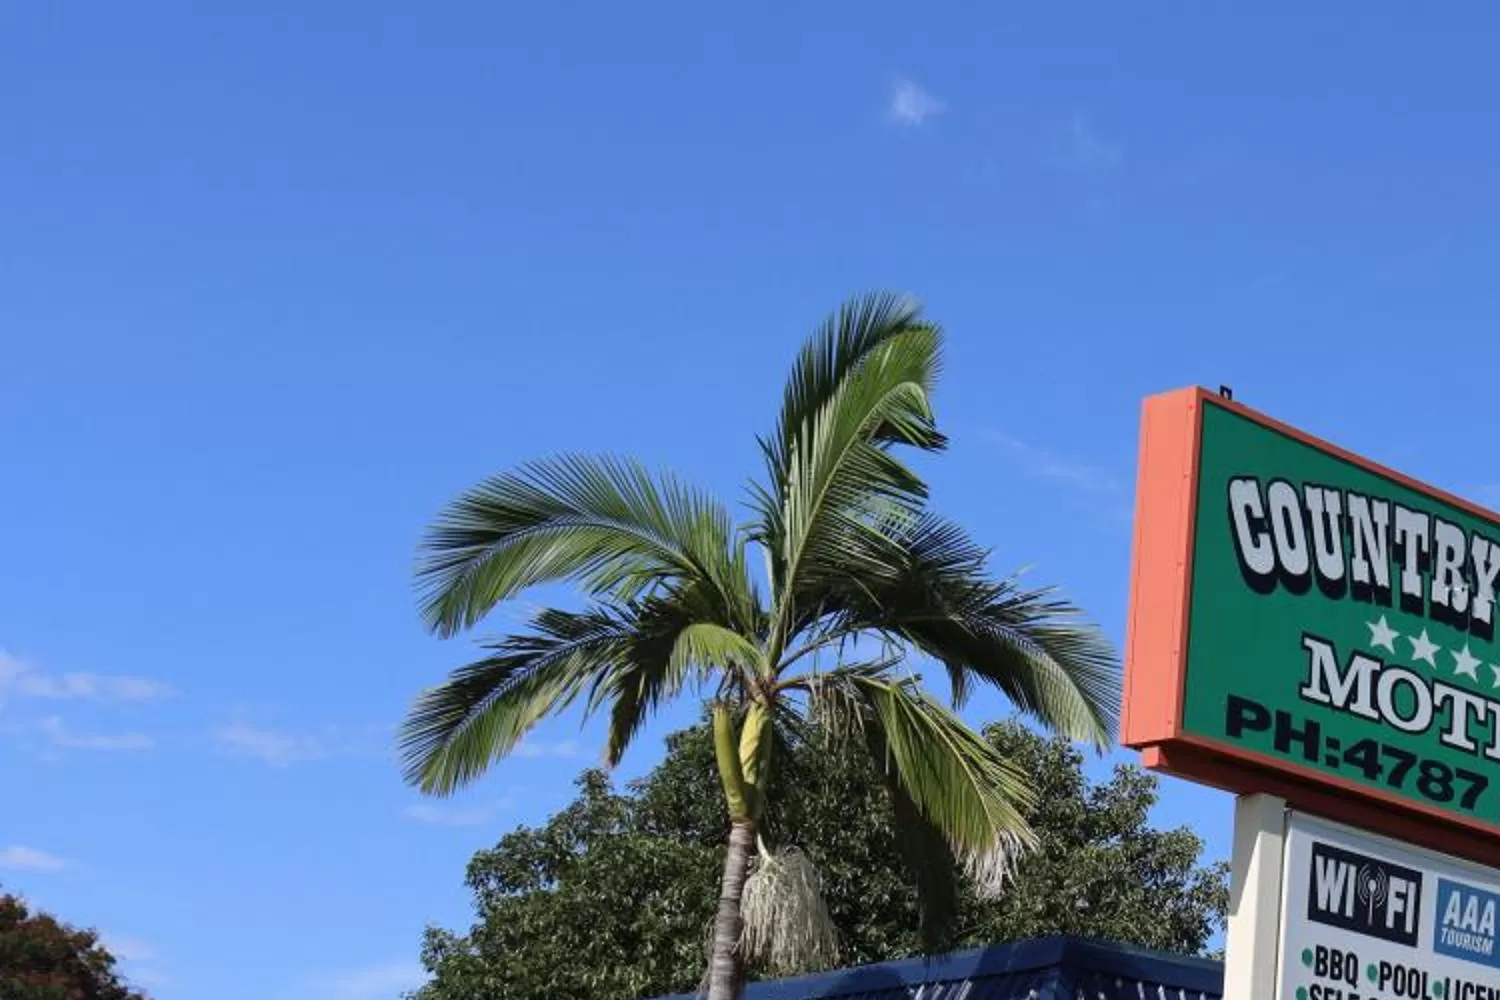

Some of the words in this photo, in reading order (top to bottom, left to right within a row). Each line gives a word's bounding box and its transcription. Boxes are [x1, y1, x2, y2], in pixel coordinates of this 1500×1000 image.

[1224, 694, 1489, 811] PH:4787
[1443, 891, 1496, 937] AAA
[1440, 927, 1494, 956] TOURISM
[1314, 945, 1359, 989] BBQ
